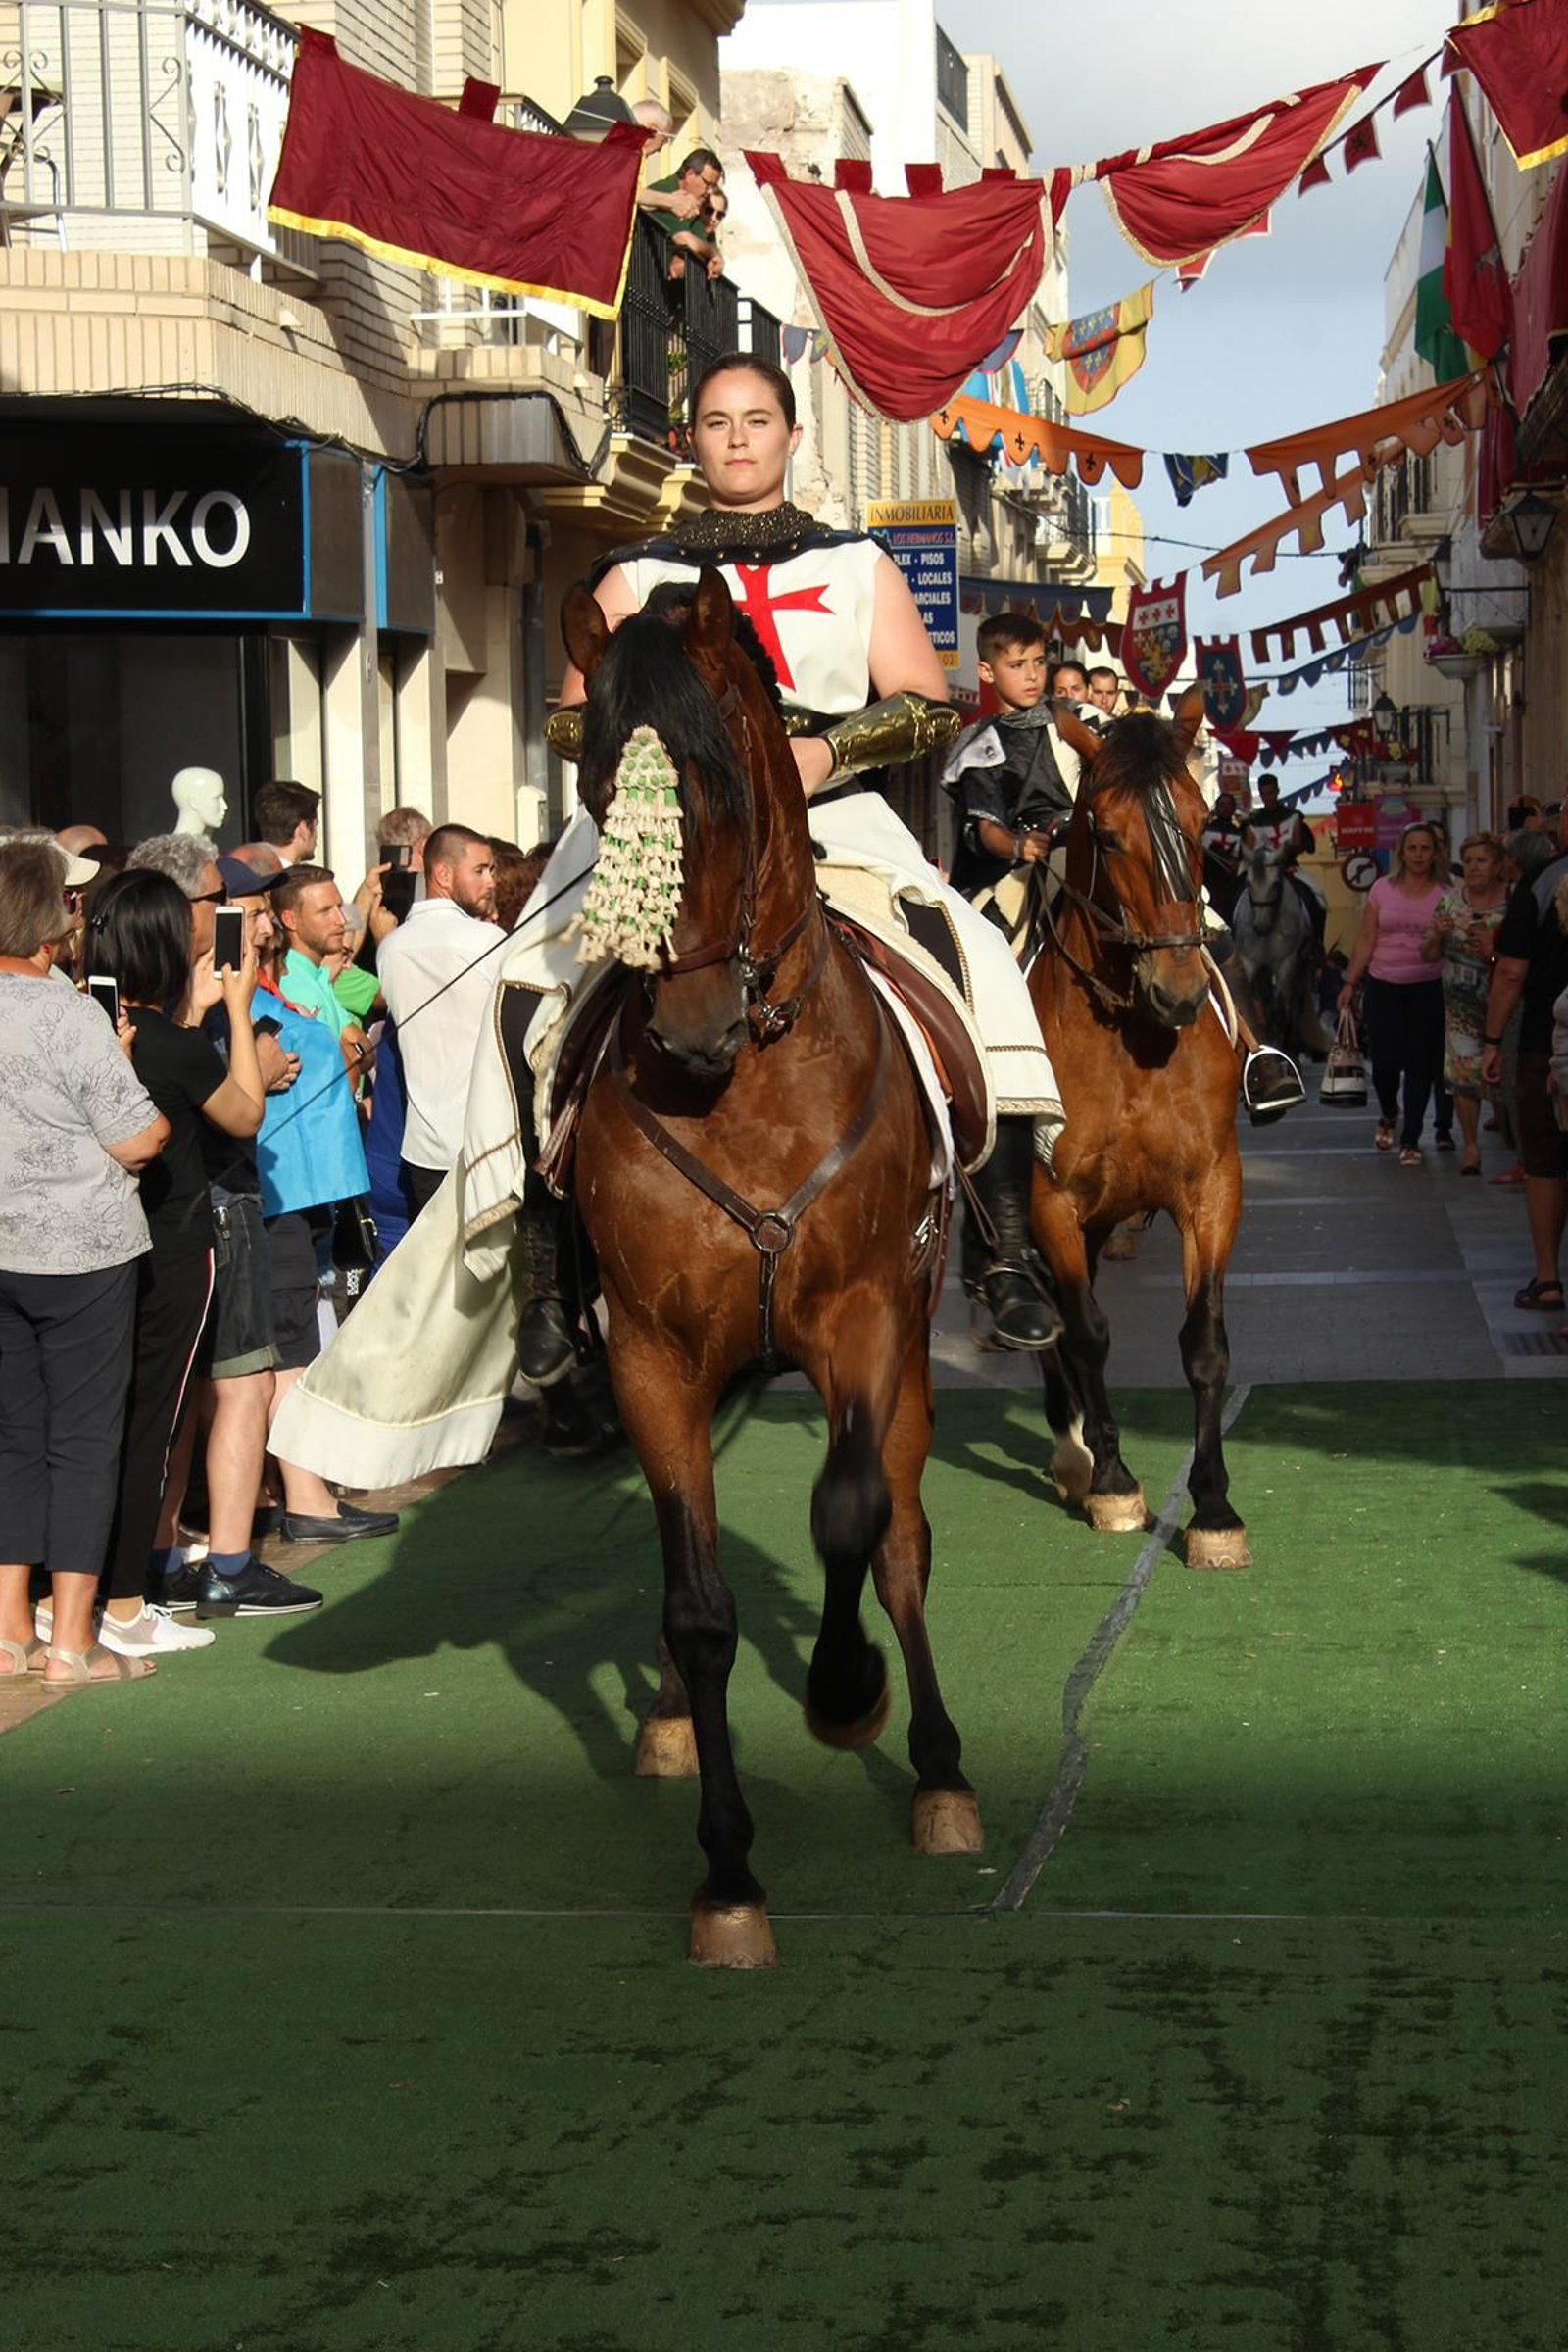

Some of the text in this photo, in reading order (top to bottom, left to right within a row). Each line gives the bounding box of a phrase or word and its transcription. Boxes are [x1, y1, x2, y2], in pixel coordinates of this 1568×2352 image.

[869, 504, 955, 523] INMOBILIARIA
[0, 488, 251, 568] ANKO
[893, 532, 906, 545] LOS
[893, 552, 945, 566] PLEX PISOS
[917, 571, 953, 585] LOCALES
